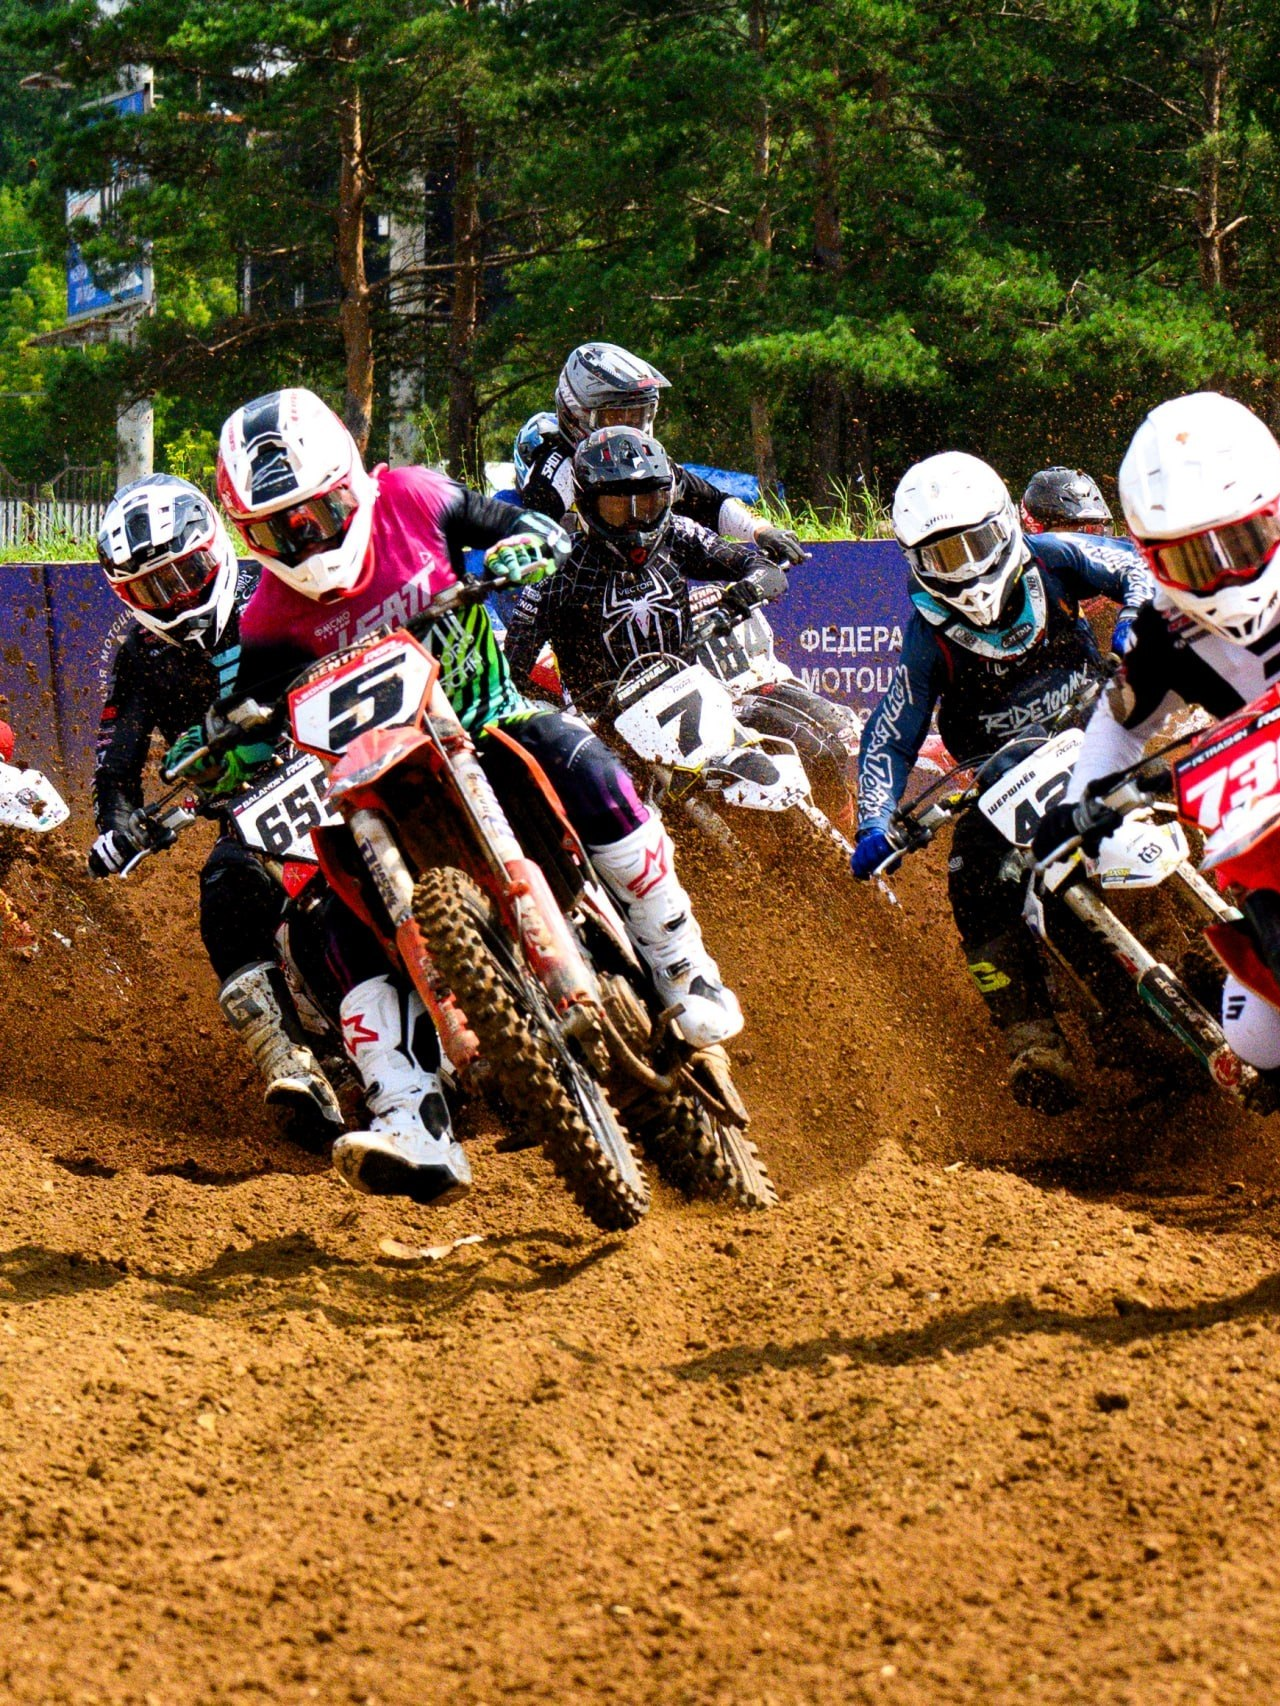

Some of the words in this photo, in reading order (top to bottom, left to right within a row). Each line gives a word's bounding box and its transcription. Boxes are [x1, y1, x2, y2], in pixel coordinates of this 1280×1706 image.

[617, 580, 653, 597] VECTOR
[329, 652, 406, 751] 5
[656, 688, 703, 758] 7
[242, 775, 285, 808] BALANDIN
[987, 770, 1036, 815] ШЕРШНЁВ
